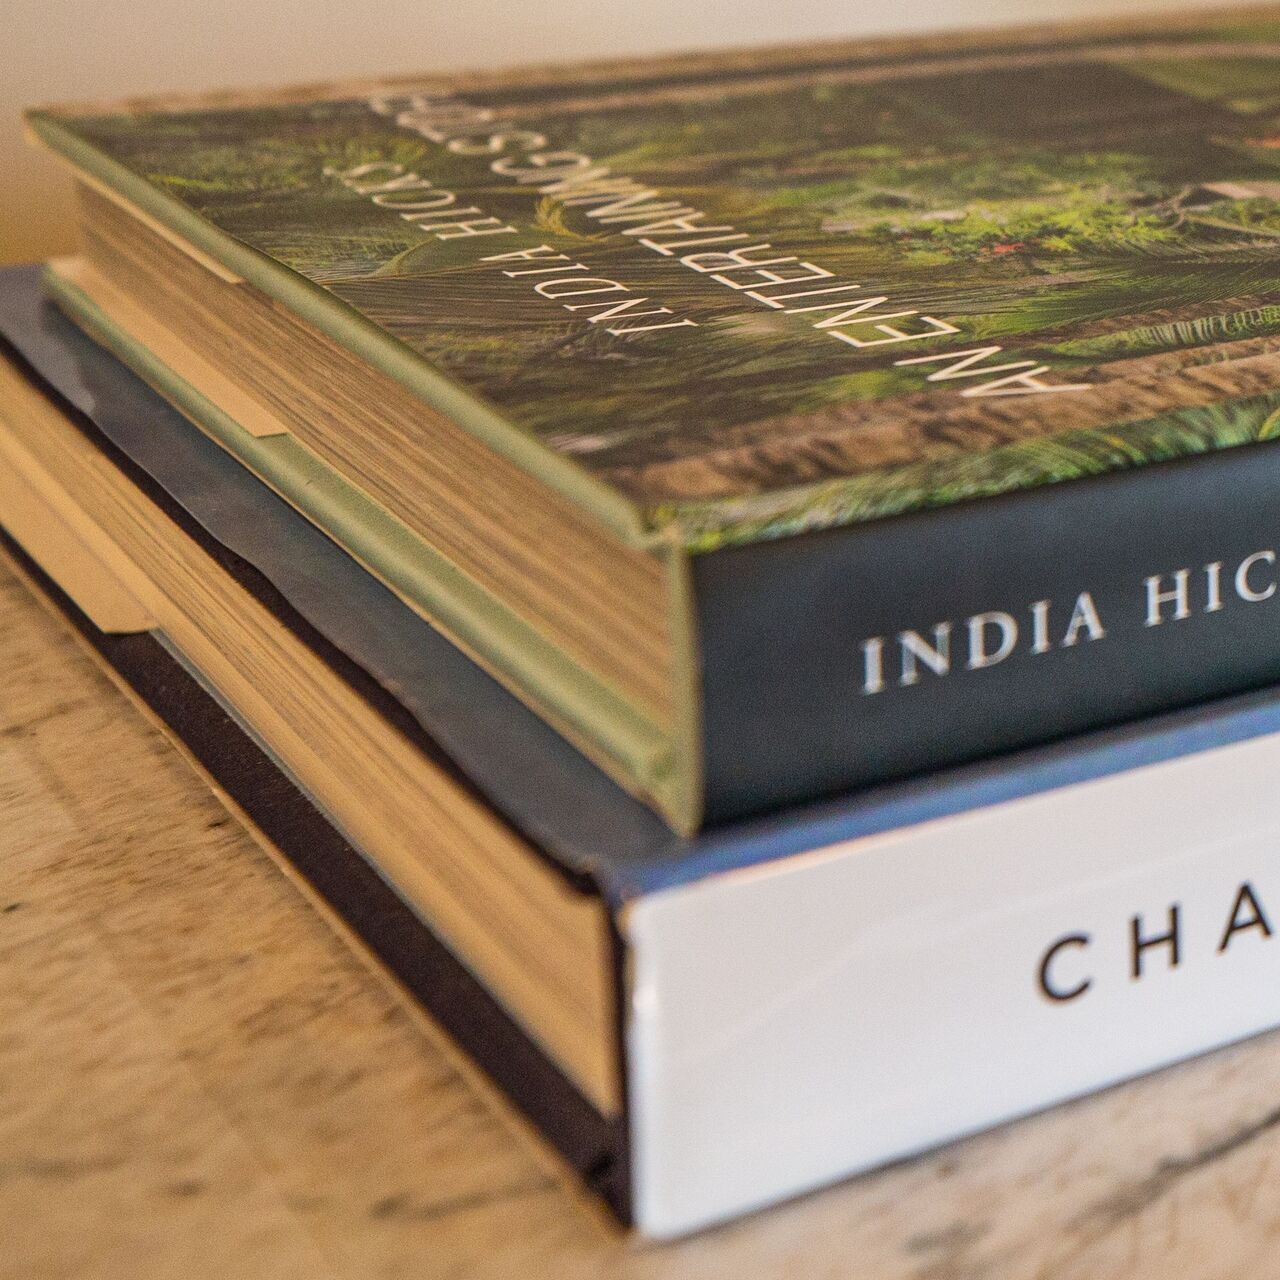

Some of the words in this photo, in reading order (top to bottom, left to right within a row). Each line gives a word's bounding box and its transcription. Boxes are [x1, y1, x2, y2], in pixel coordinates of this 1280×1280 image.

[322, 161, 519, 242] HICKS
[478, 243, 700, 337] INDIA
[893, 345, 1093, 398] AN
[861, 591, 1106, 696] INDIA
